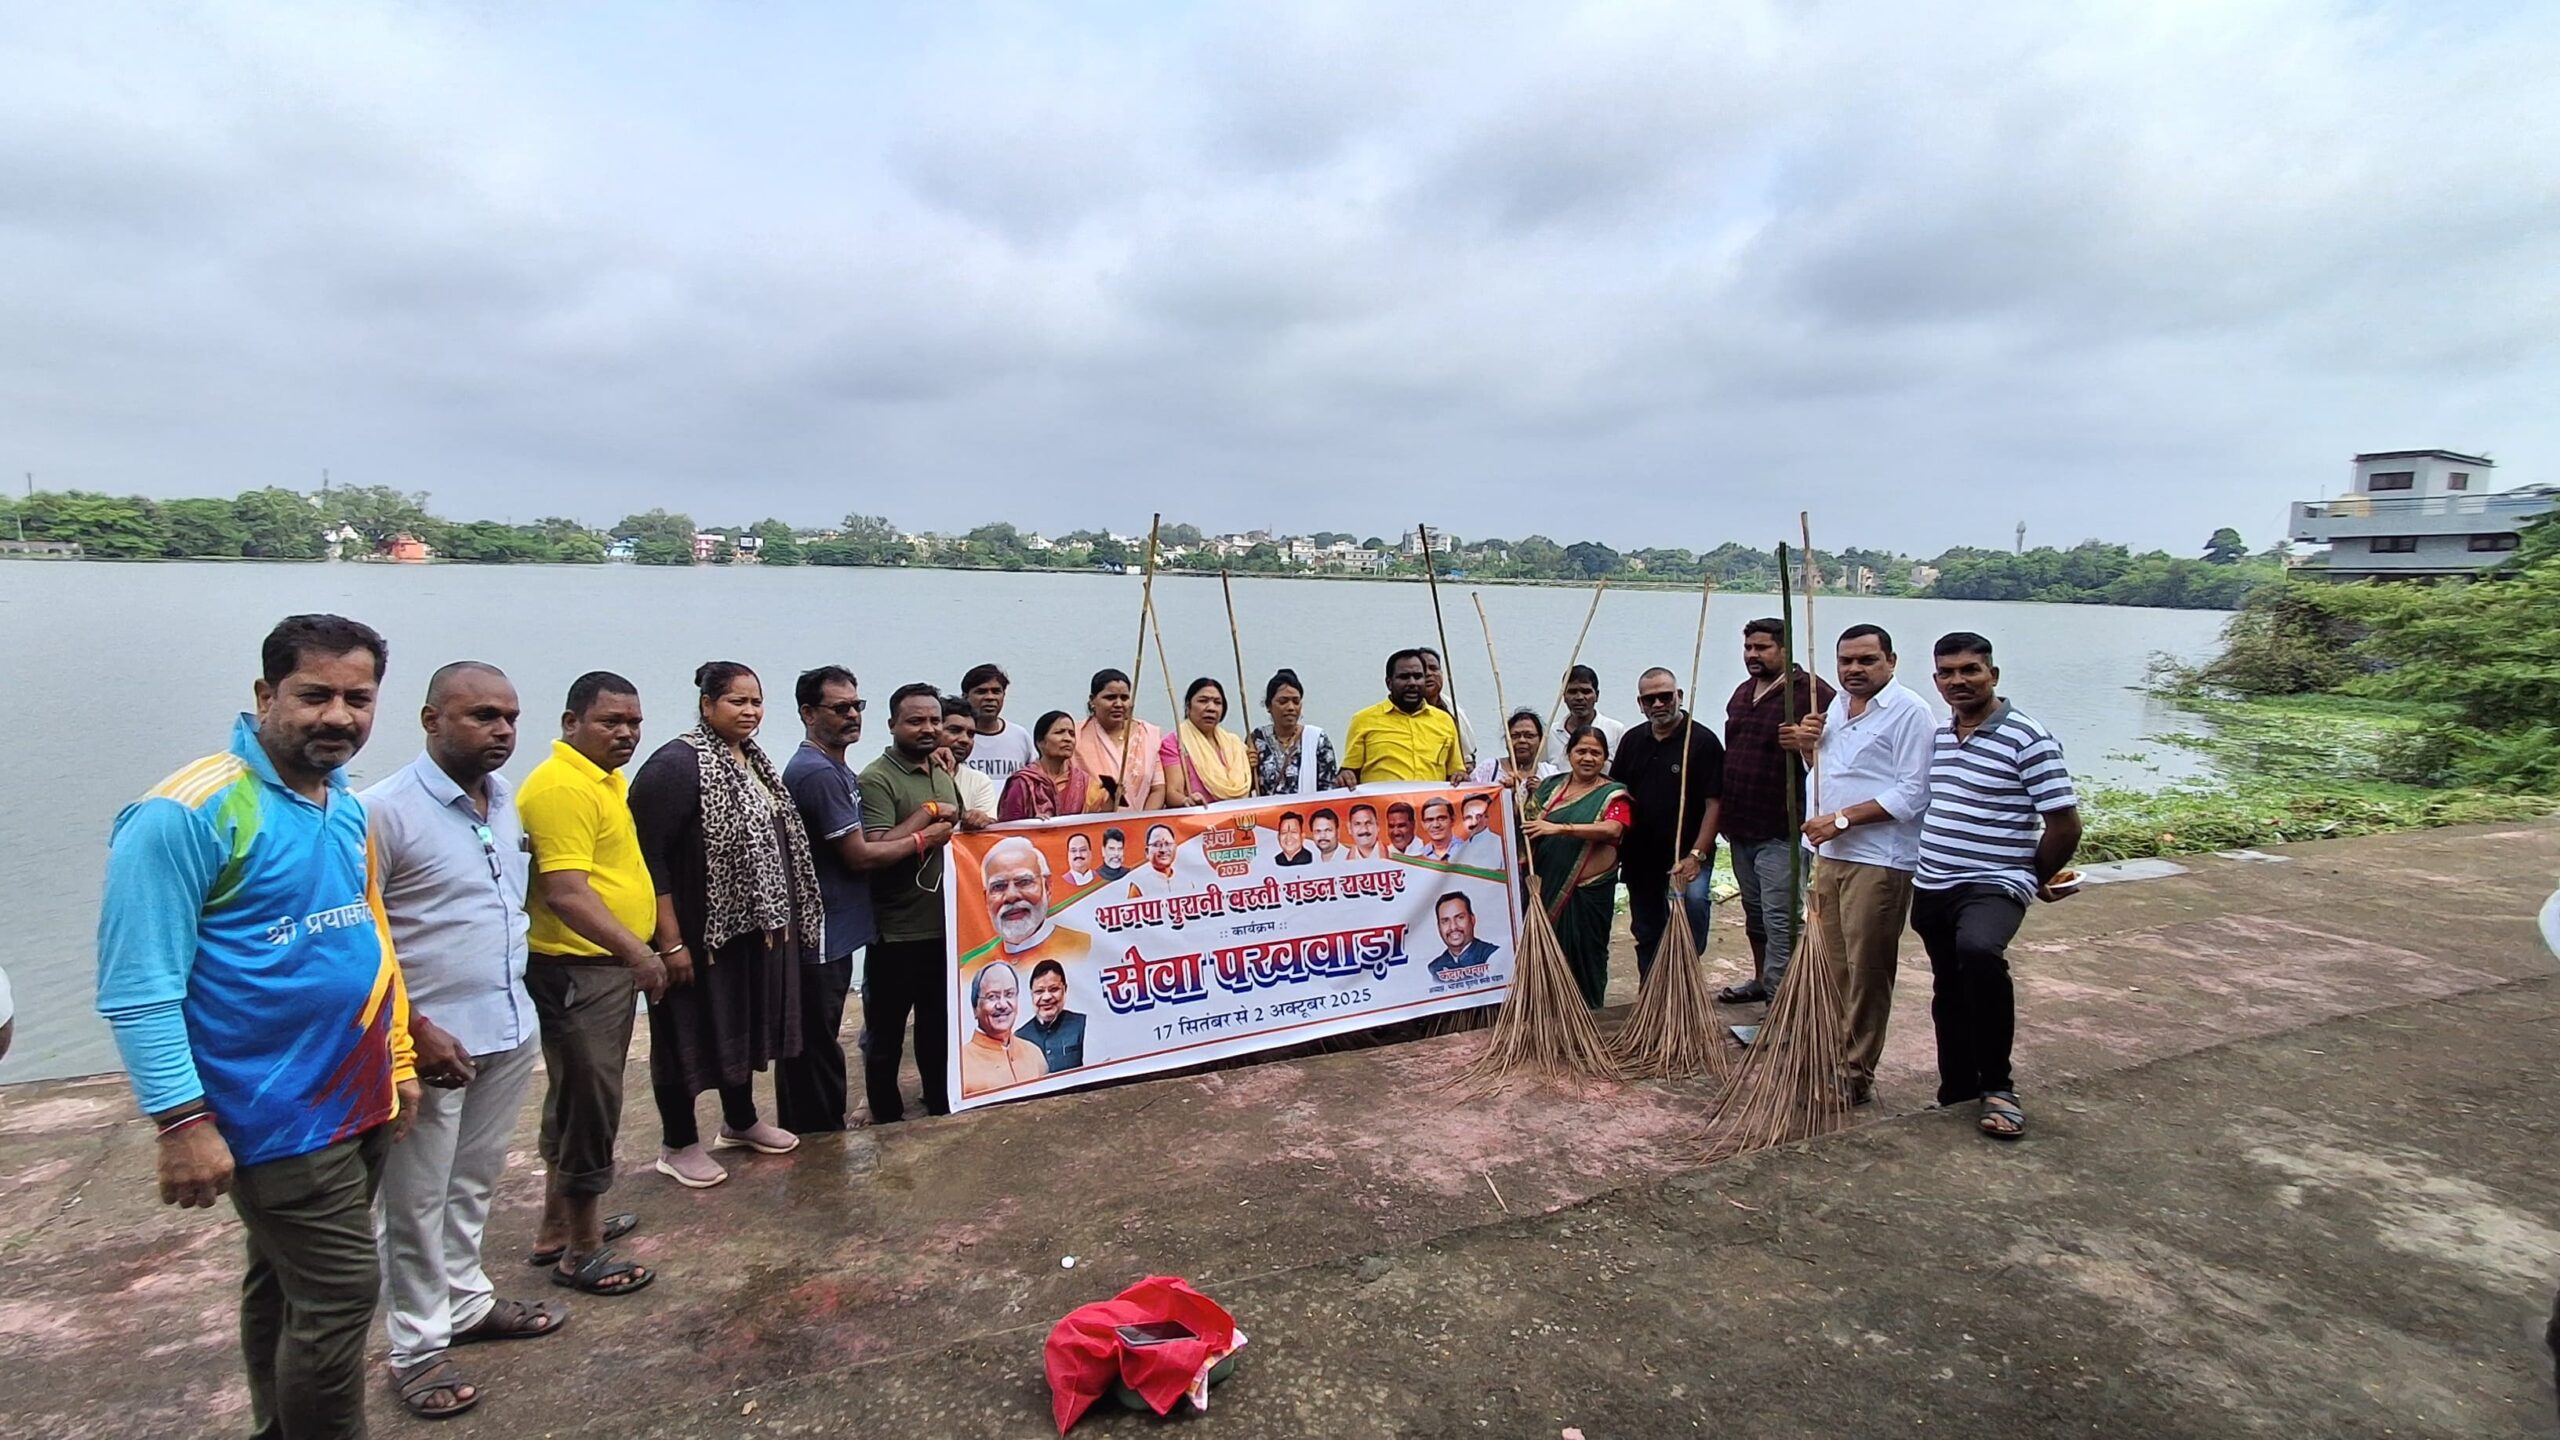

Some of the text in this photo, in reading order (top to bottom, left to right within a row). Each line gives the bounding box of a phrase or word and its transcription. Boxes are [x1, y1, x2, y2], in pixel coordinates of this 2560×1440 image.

[1203, 825, 1233, 847] सेवा
[1219, 863, 1247, 877] 2025
[1096, 900, 1163, 932] भाजपा
[1166, 884, 1225, 930] पुरानी
[1284, 875, 1338, 905] मंडल
[1340, 869, 1405, 901] रायपुर
[266, 915, 299, 945] श्री
[1231, 920, 1275, 936] कार्यक्रम
[1102, 923, 1409, 1014] सेवा पखवाड़ा
[1154, 988, 1372, 1040] 17 सितंबर से 2 अक्टूबर 2025
